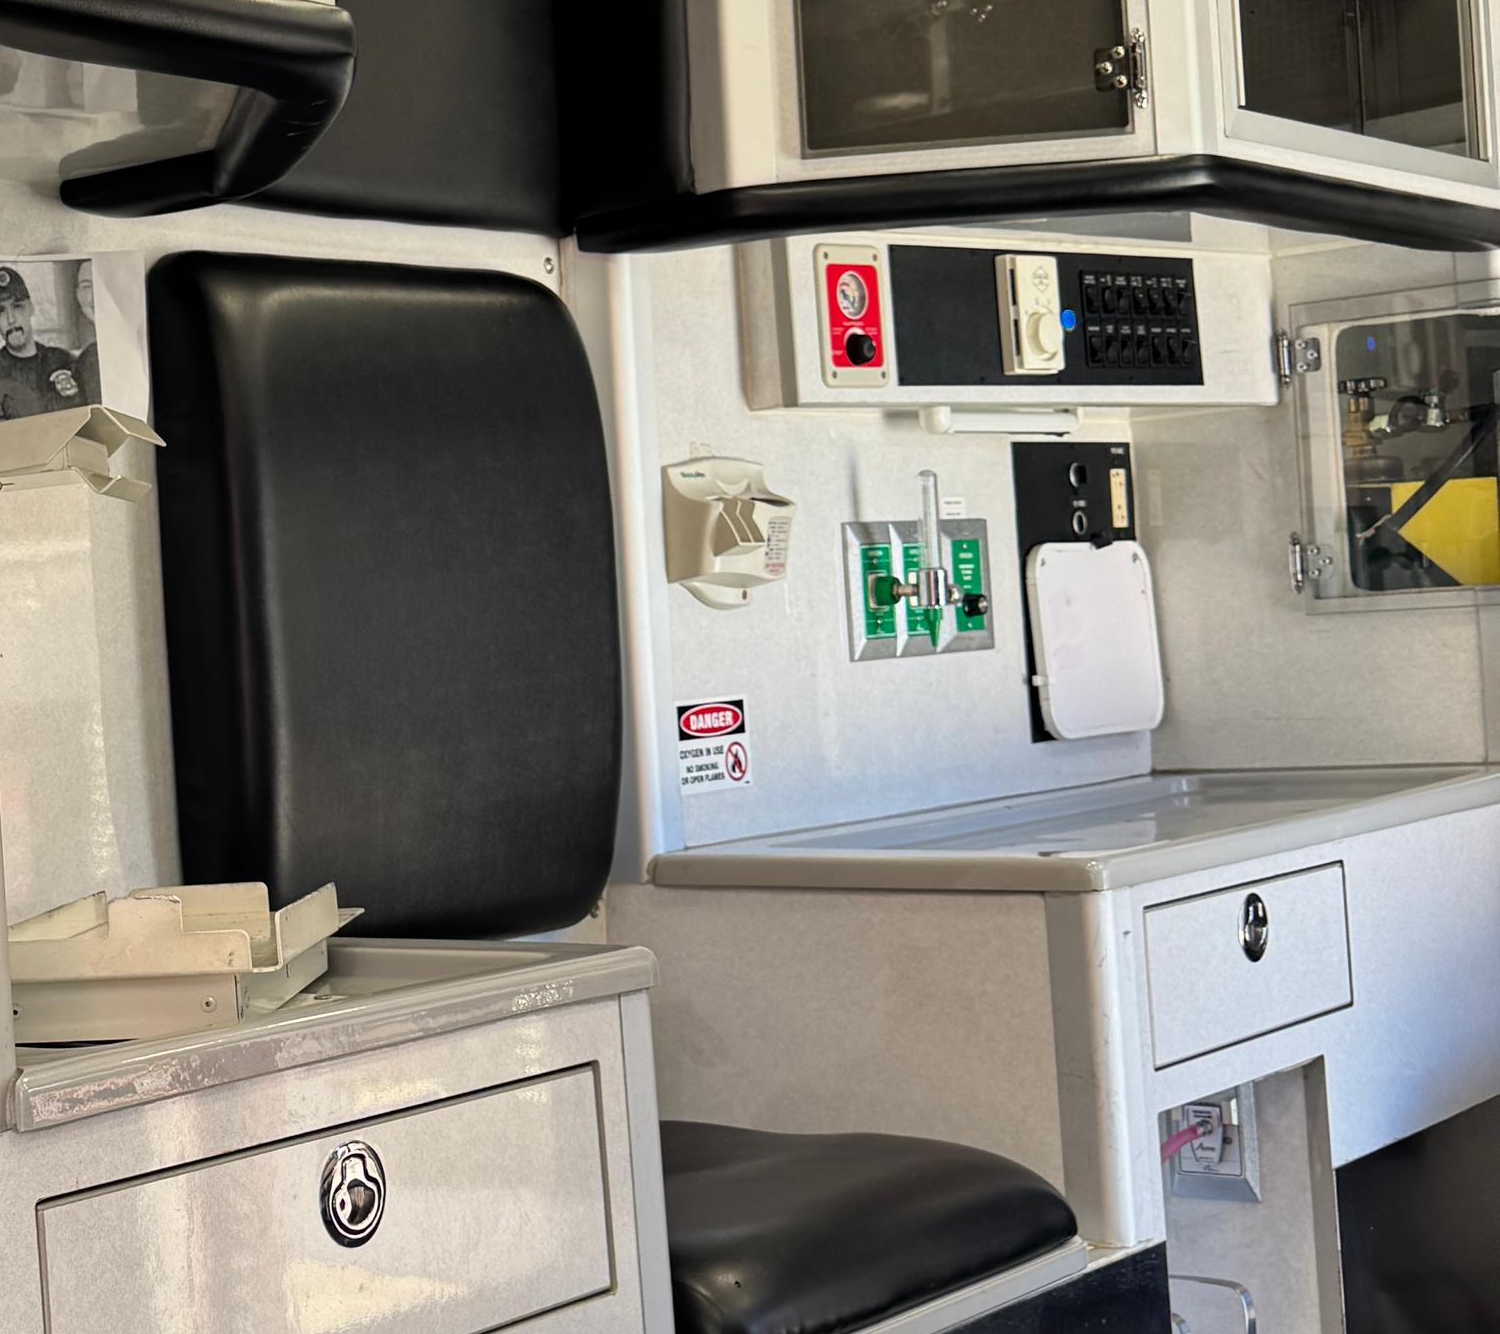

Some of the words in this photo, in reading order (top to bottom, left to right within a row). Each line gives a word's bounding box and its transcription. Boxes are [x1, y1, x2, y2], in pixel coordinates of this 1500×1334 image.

[689, 711, 734, 731] DANGER
[679, 748, 704, 759] OXYGEN
[705, 747, 712, 756] IN
[713, 745, 724, 755] USE
[686, 765, 694, 773] NO
[695, 762, 719, 772] SMOKING
[681, 777, 689, 785] OR
[690, 775, 704, 784] OPEN
[705, 772, 725, 782] FLAMES
